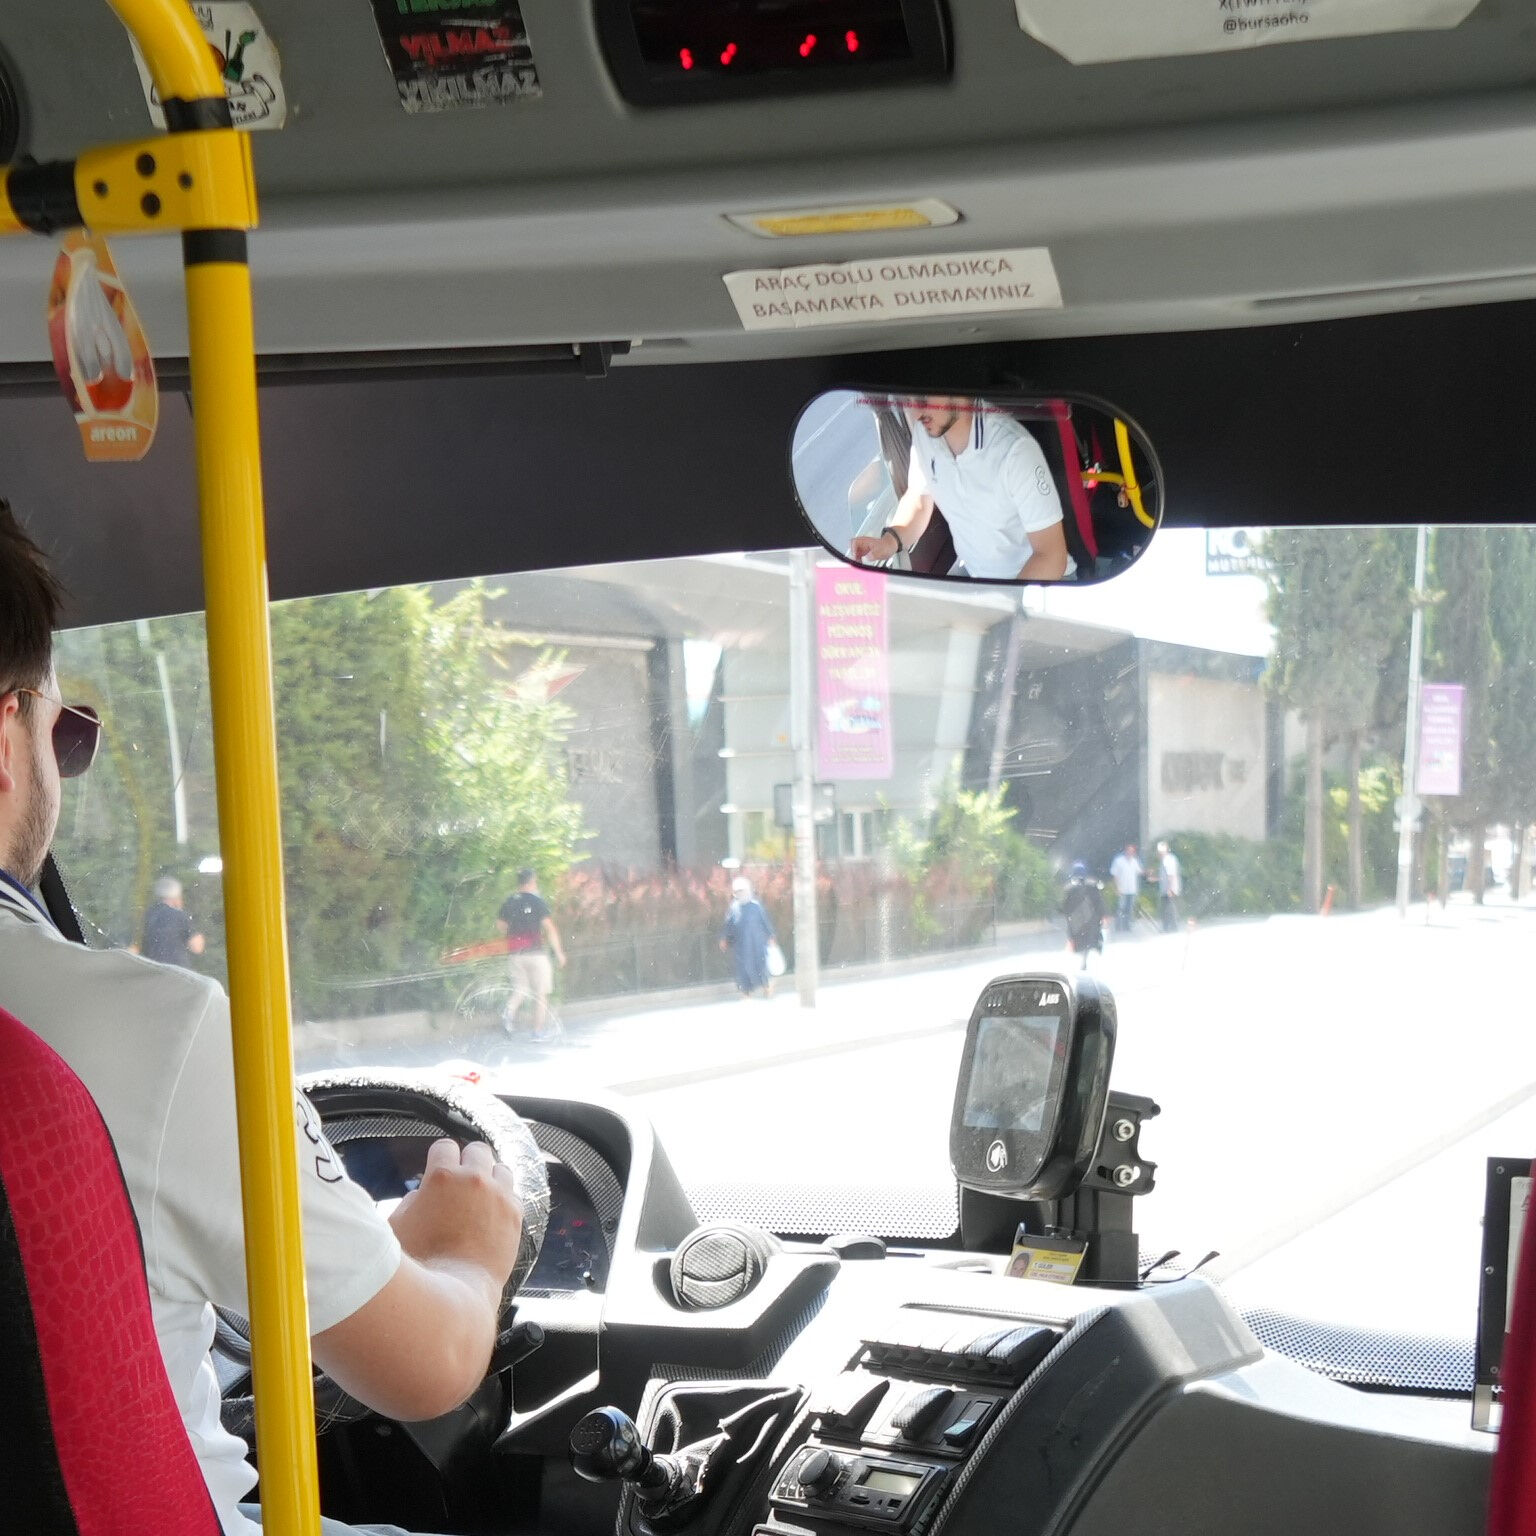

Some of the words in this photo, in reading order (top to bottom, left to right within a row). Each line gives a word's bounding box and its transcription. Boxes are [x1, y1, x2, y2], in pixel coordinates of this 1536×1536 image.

[754, 272, 811, 292] ARAÇ
[815, 267, 874, 287] DOLU
[880, 259, 1014, 282] OLMADIKÇA
[752, 294, 884, 318] BASAMAKTA
[894, 284, 1035, 307] DURMAYINIZ
